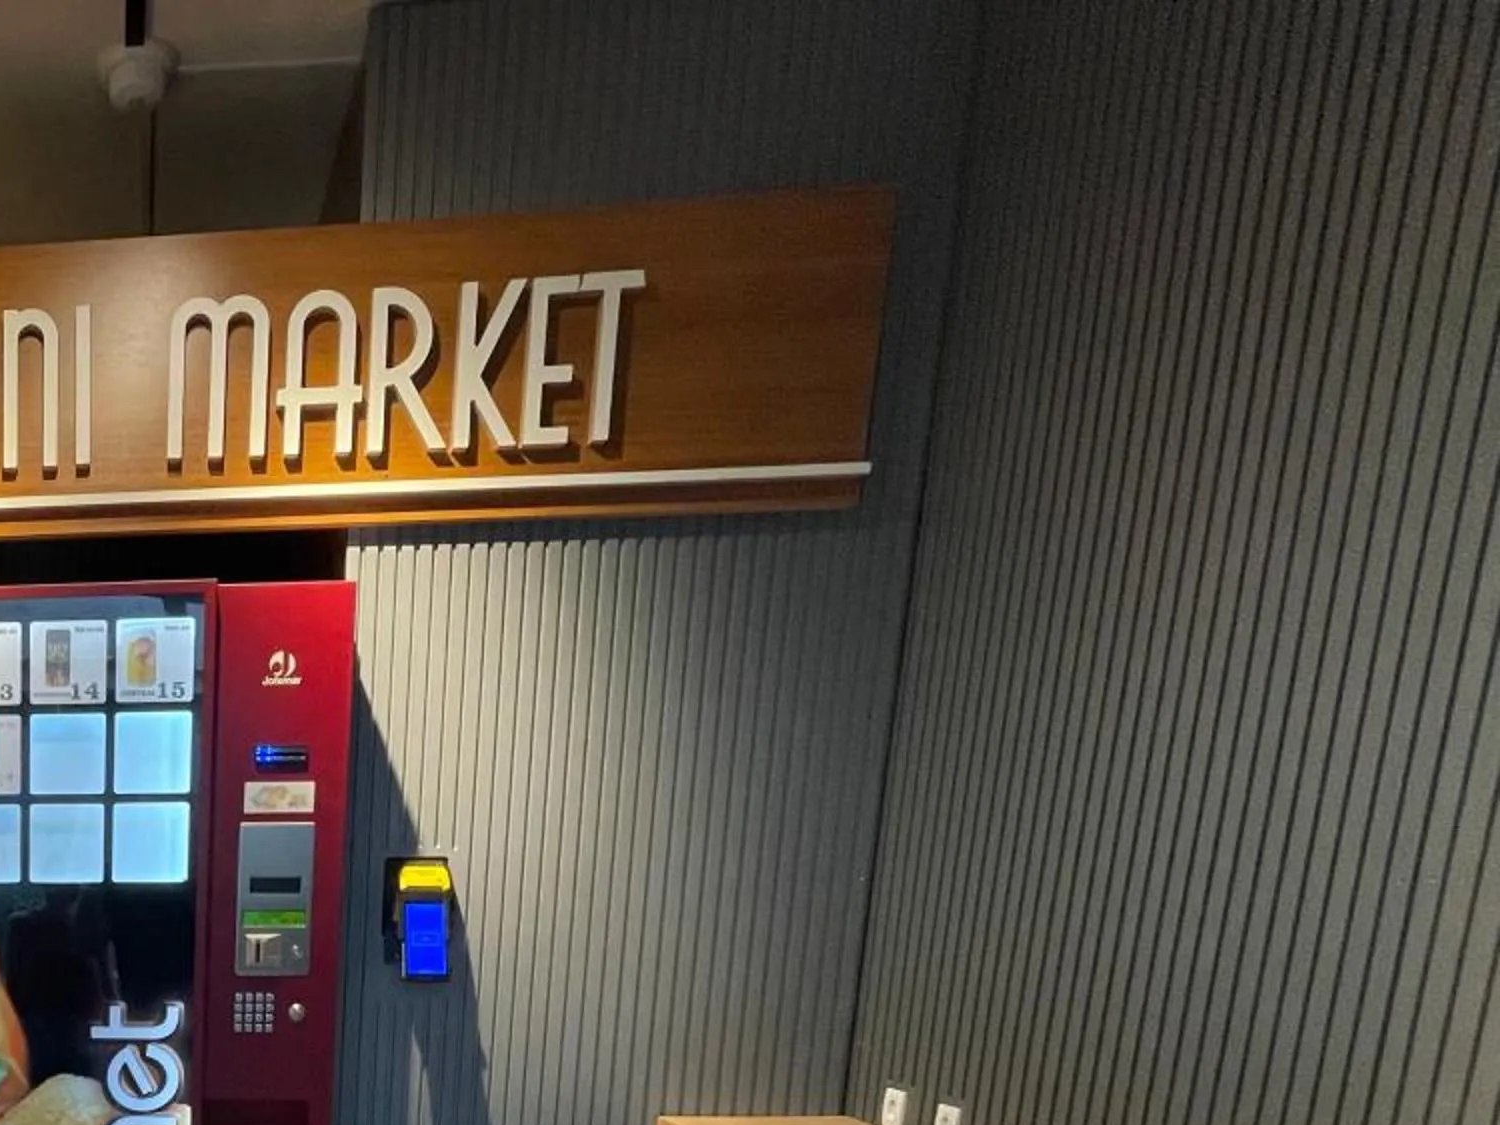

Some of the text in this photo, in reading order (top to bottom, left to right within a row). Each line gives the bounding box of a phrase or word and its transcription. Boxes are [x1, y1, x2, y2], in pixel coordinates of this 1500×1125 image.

[166, 268, 646, 472] MARKET
[71, 682, 100, 700] 14
[157, 681, 186, 699] 15
